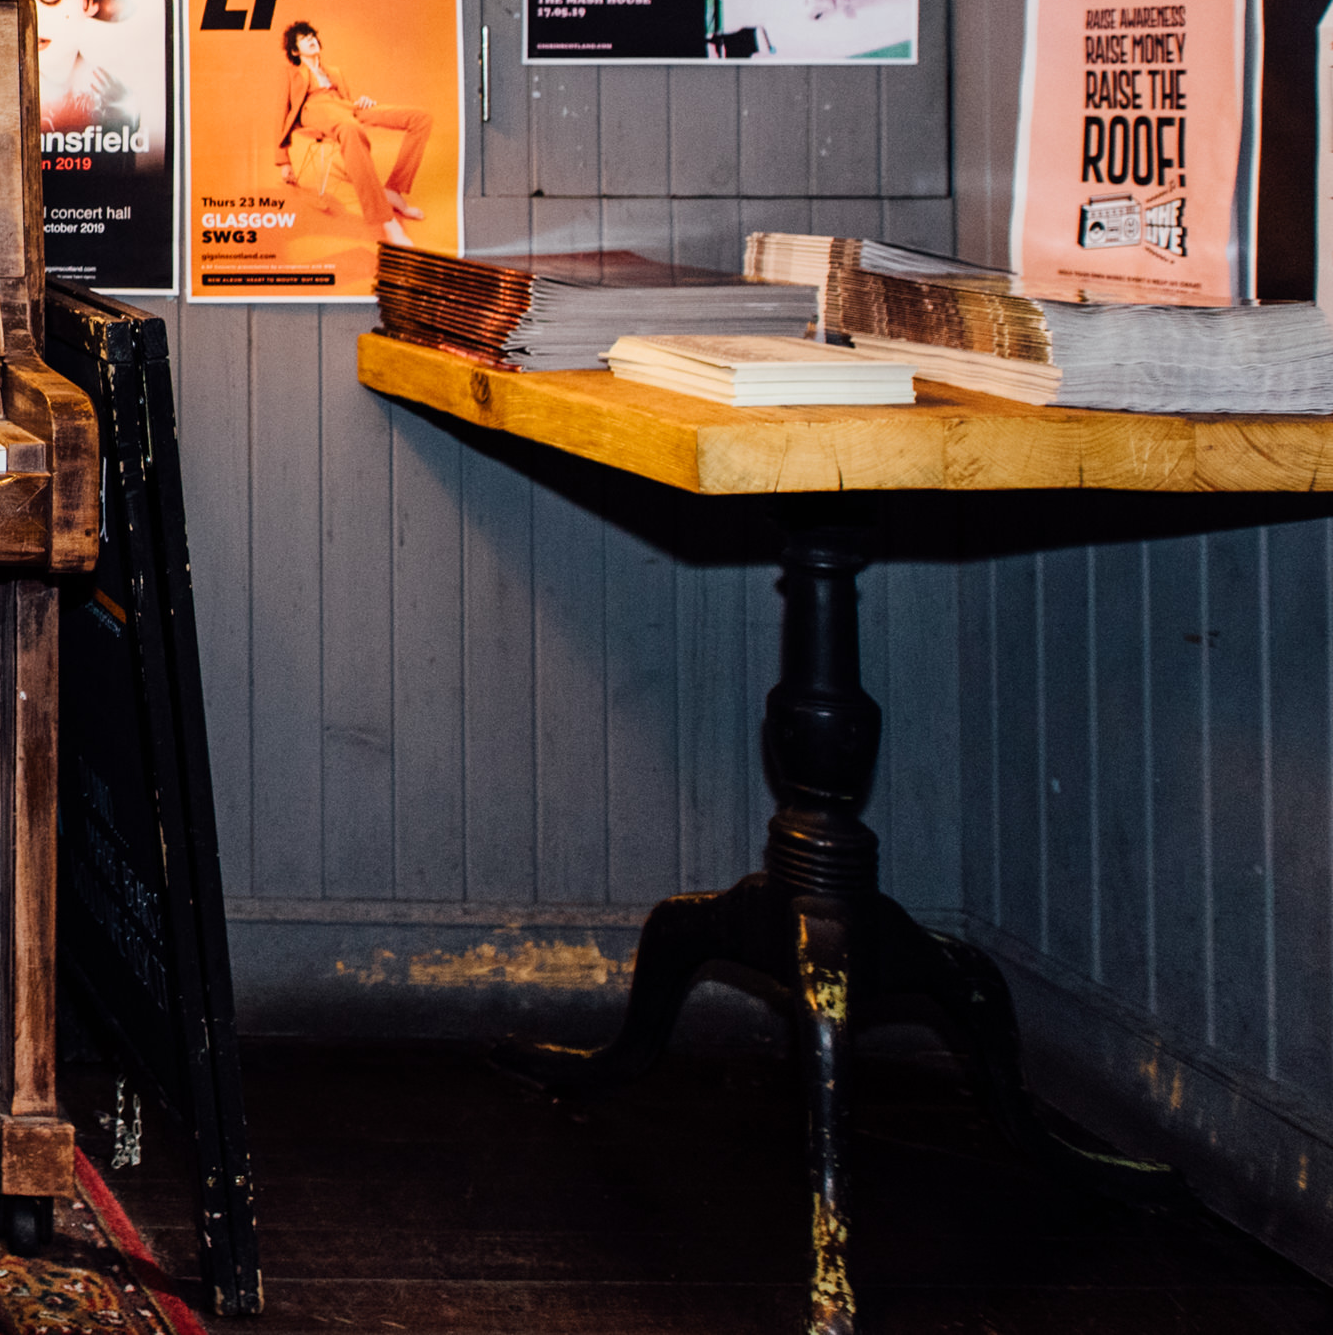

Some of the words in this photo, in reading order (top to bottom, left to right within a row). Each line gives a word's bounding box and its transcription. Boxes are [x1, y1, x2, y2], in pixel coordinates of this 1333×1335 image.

[1086, 8, 1116, 30] RAISE
[1119, 5, 1186, 29] AWARENESS
[1085, 35, 1129, 64] RAISE
[1132, 33, 1186, 63] MONEY
[1085, 70, 1142, 109] RAISE
[1147, 70, 1187, 110] THE
[41, 125, 150, 153] nsfield
[1082, 116, 1187, 187] ROOF!
[55, 157, 92, 170] 2019
[202, 197, 236, 207] Thurs
[239, 197, 256, 207] 23
[259, 197, 285, 210] May
[51, 207, 102, 219] concert
[106, 206, 131, 219] hall
[202, 212, 296, 228] GLASGOW
[44, 223, 77, 233] ctober
[80, 223, 105, 233] 2019
[202, 230, 258, 244] SWG3
